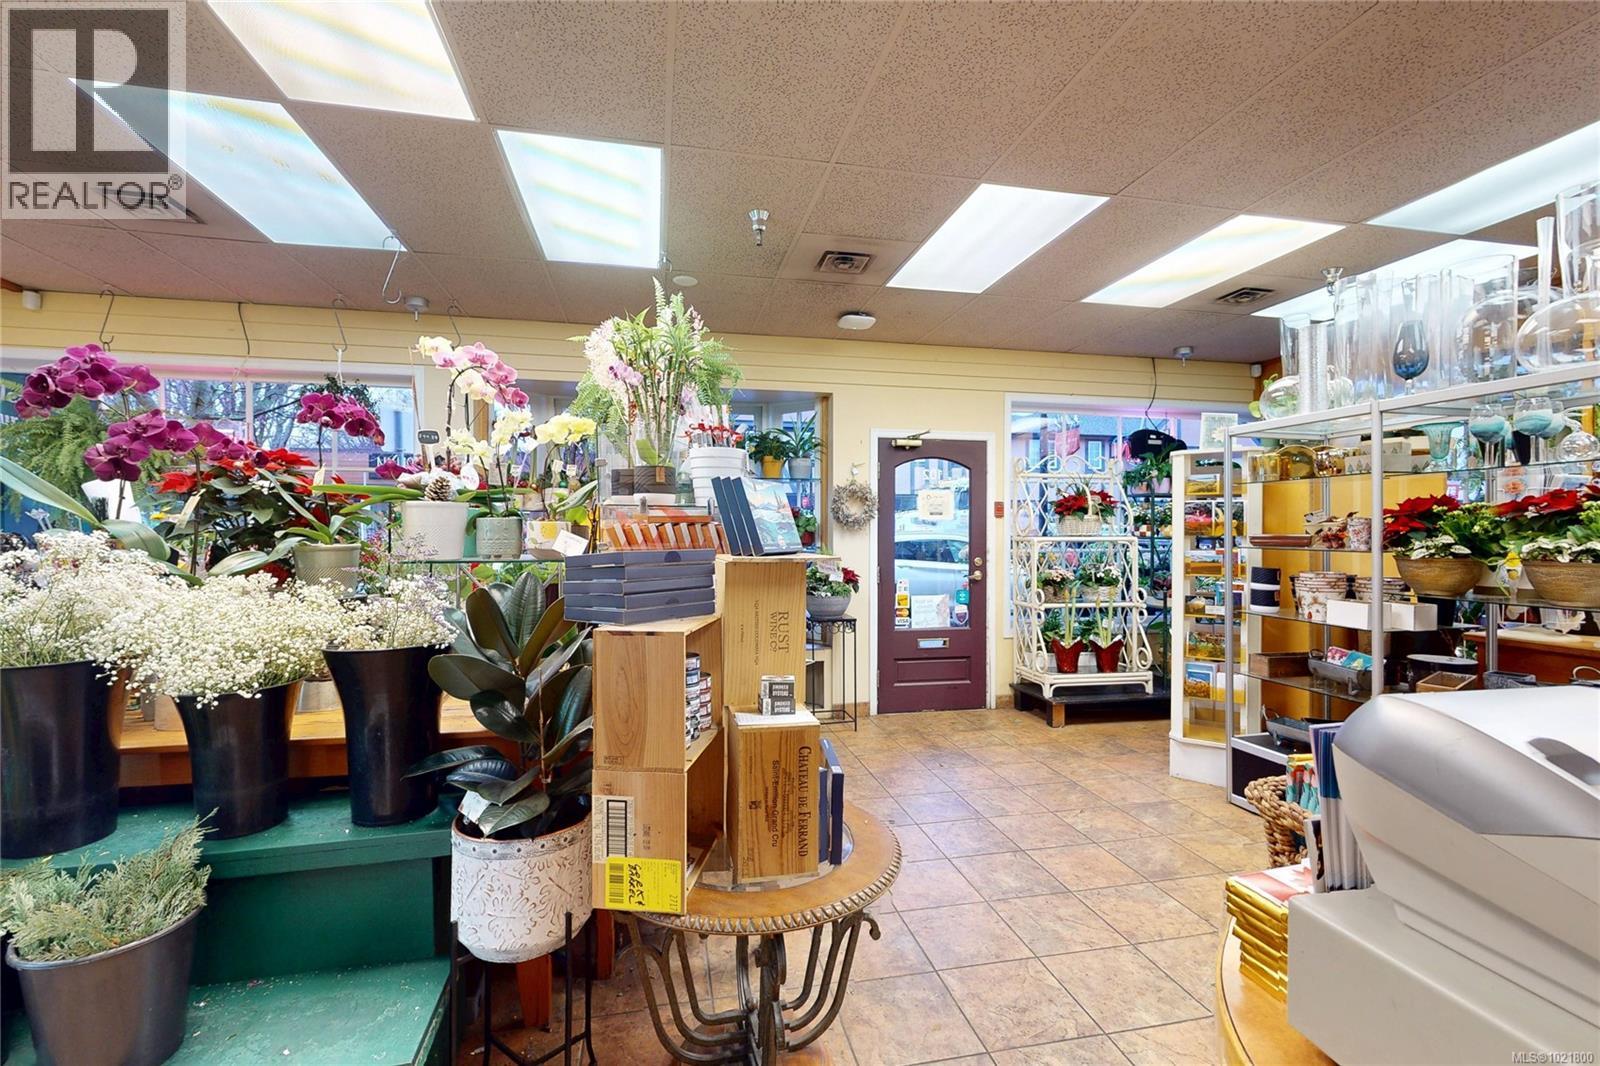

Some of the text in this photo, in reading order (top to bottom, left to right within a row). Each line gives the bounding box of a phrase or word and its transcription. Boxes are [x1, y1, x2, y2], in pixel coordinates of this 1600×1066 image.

[769, 611, 778, 639] WINE
[778, 611, 790, 653] RUST
[798, 746, 812, 857] CHATEAU DE FERRAND
[771, 809, 780, 833] Grand
[771, 834, 779, 848] Cru
